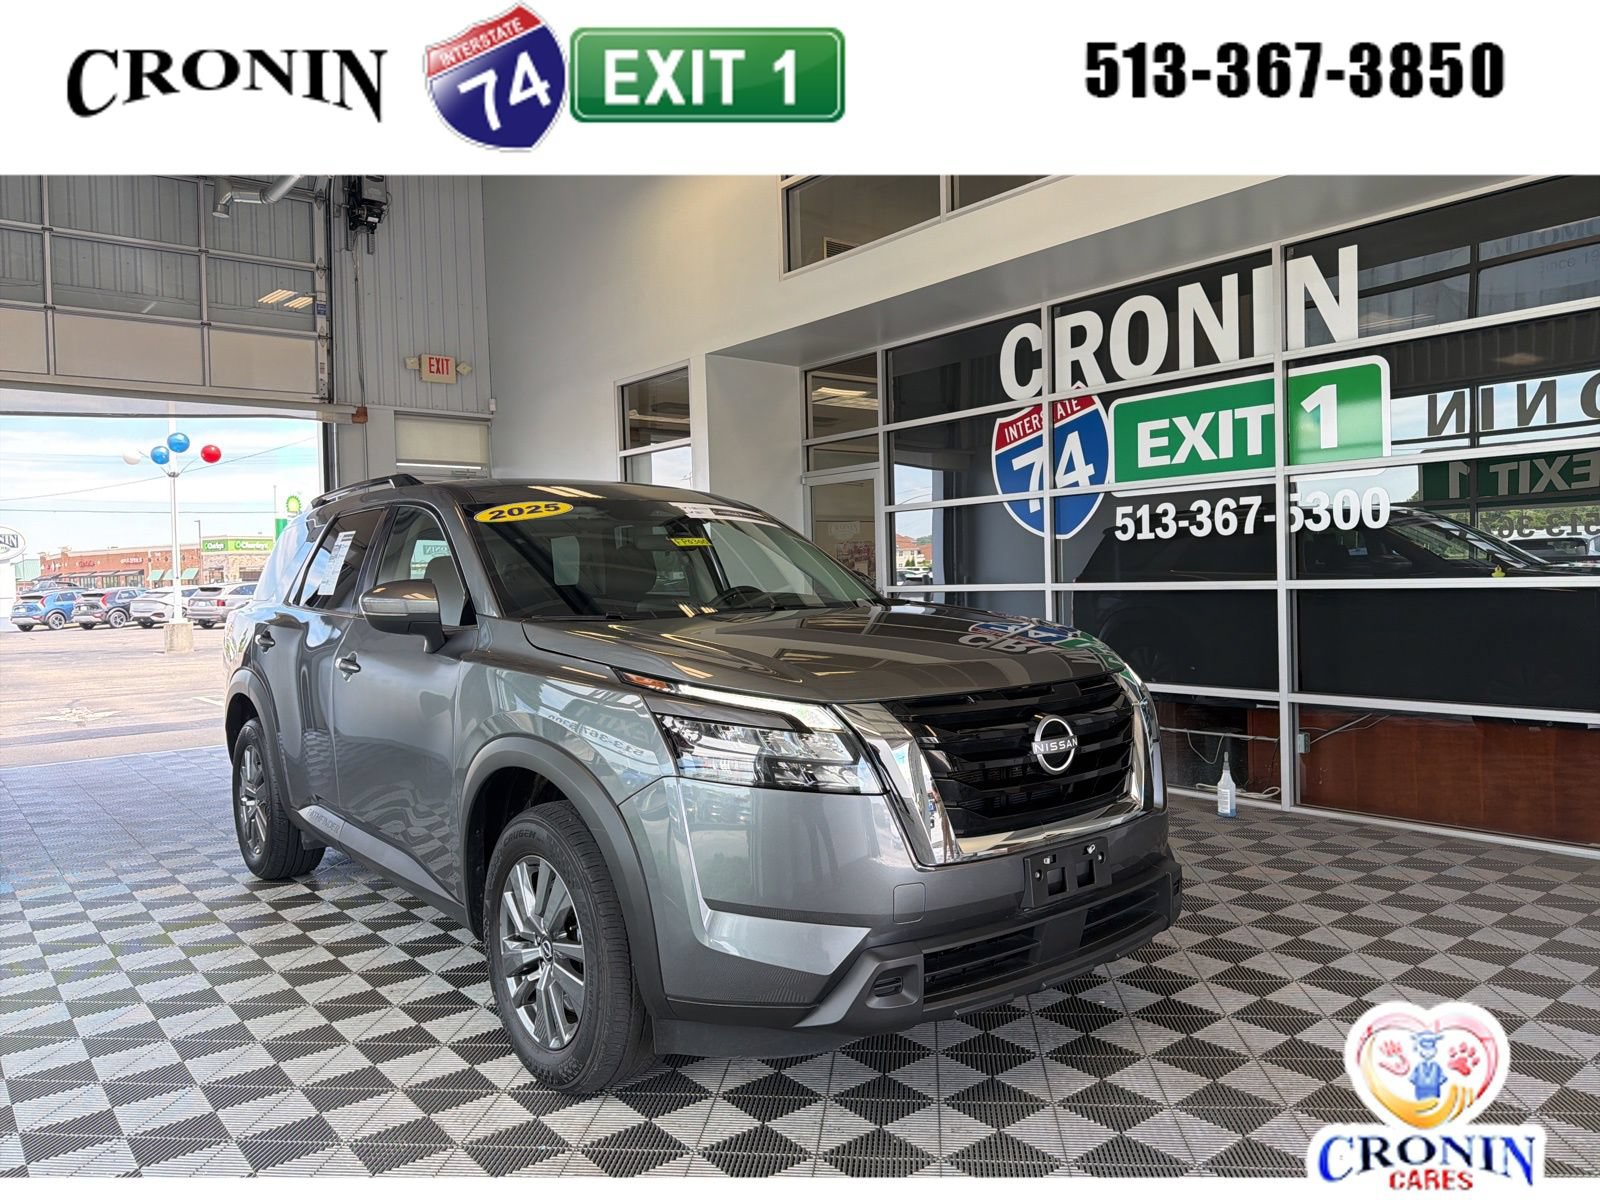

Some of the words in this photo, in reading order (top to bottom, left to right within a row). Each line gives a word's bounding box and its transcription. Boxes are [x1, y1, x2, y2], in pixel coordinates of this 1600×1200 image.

[1000, 244, 1359, 400] CRONIN
[428, 356, 451, 375] EXIT
[1004, 398, 1082, 443] INTERATE
[1137, 403, 1275, 469] EXIT
[1300, 383, 1339, 450] 1
[1011, 430, 1096, 514] 74
[488, 503, 561, 520] 2025
[1034, 738, 1078, 753] NISSAN
